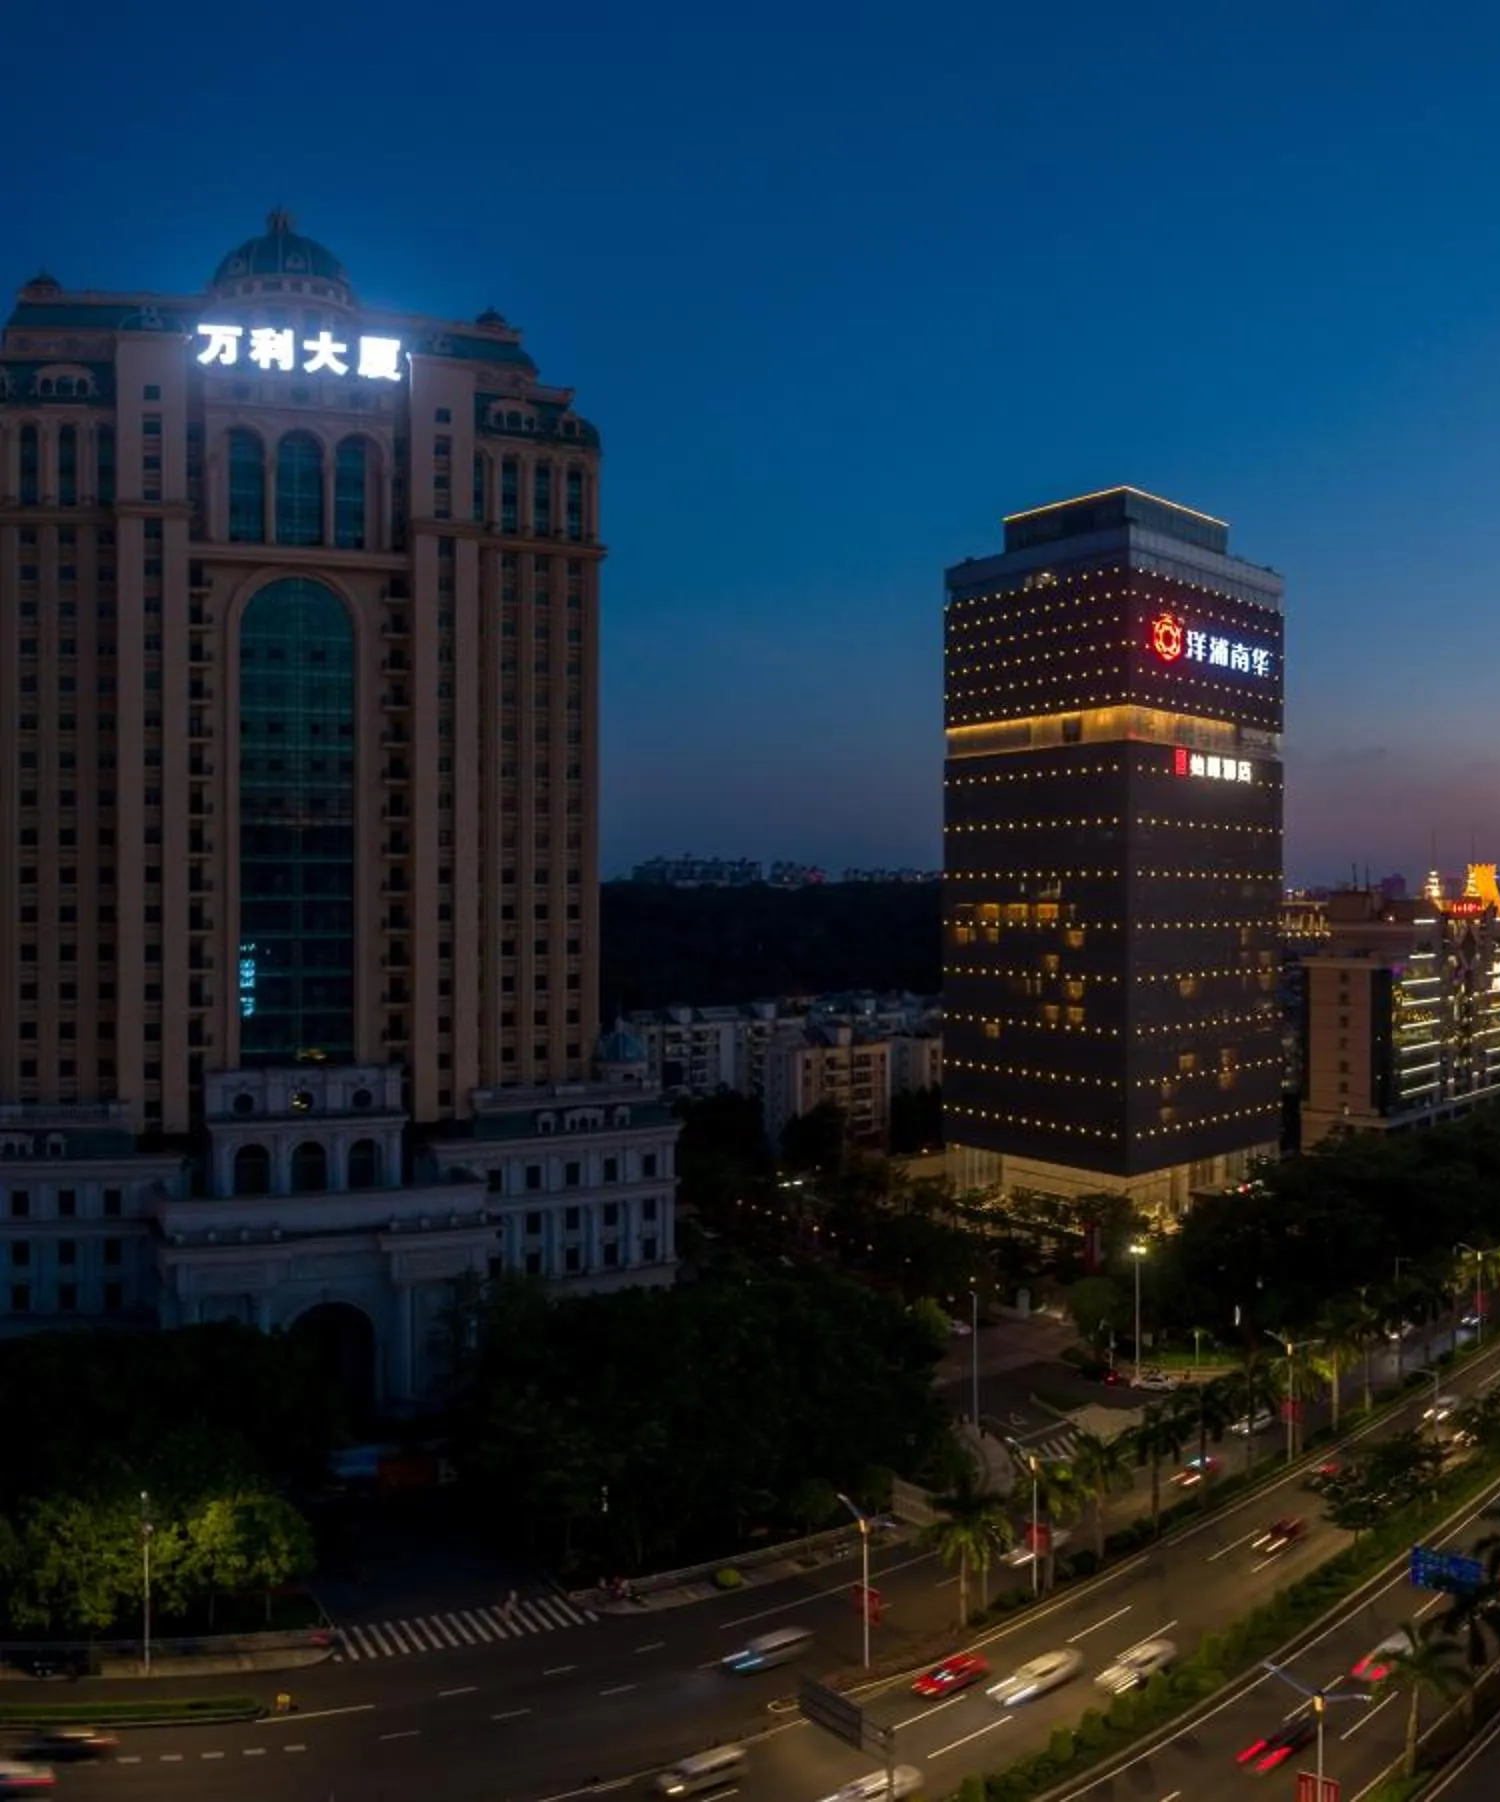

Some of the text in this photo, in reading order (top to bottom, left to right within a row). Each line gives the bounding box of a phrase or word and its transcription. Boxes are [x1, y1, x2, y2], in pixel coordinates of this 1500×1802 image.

[197, 324, 402, 381] 万利大厦
[1184, 629, 1271, 677] 洋浦南华
